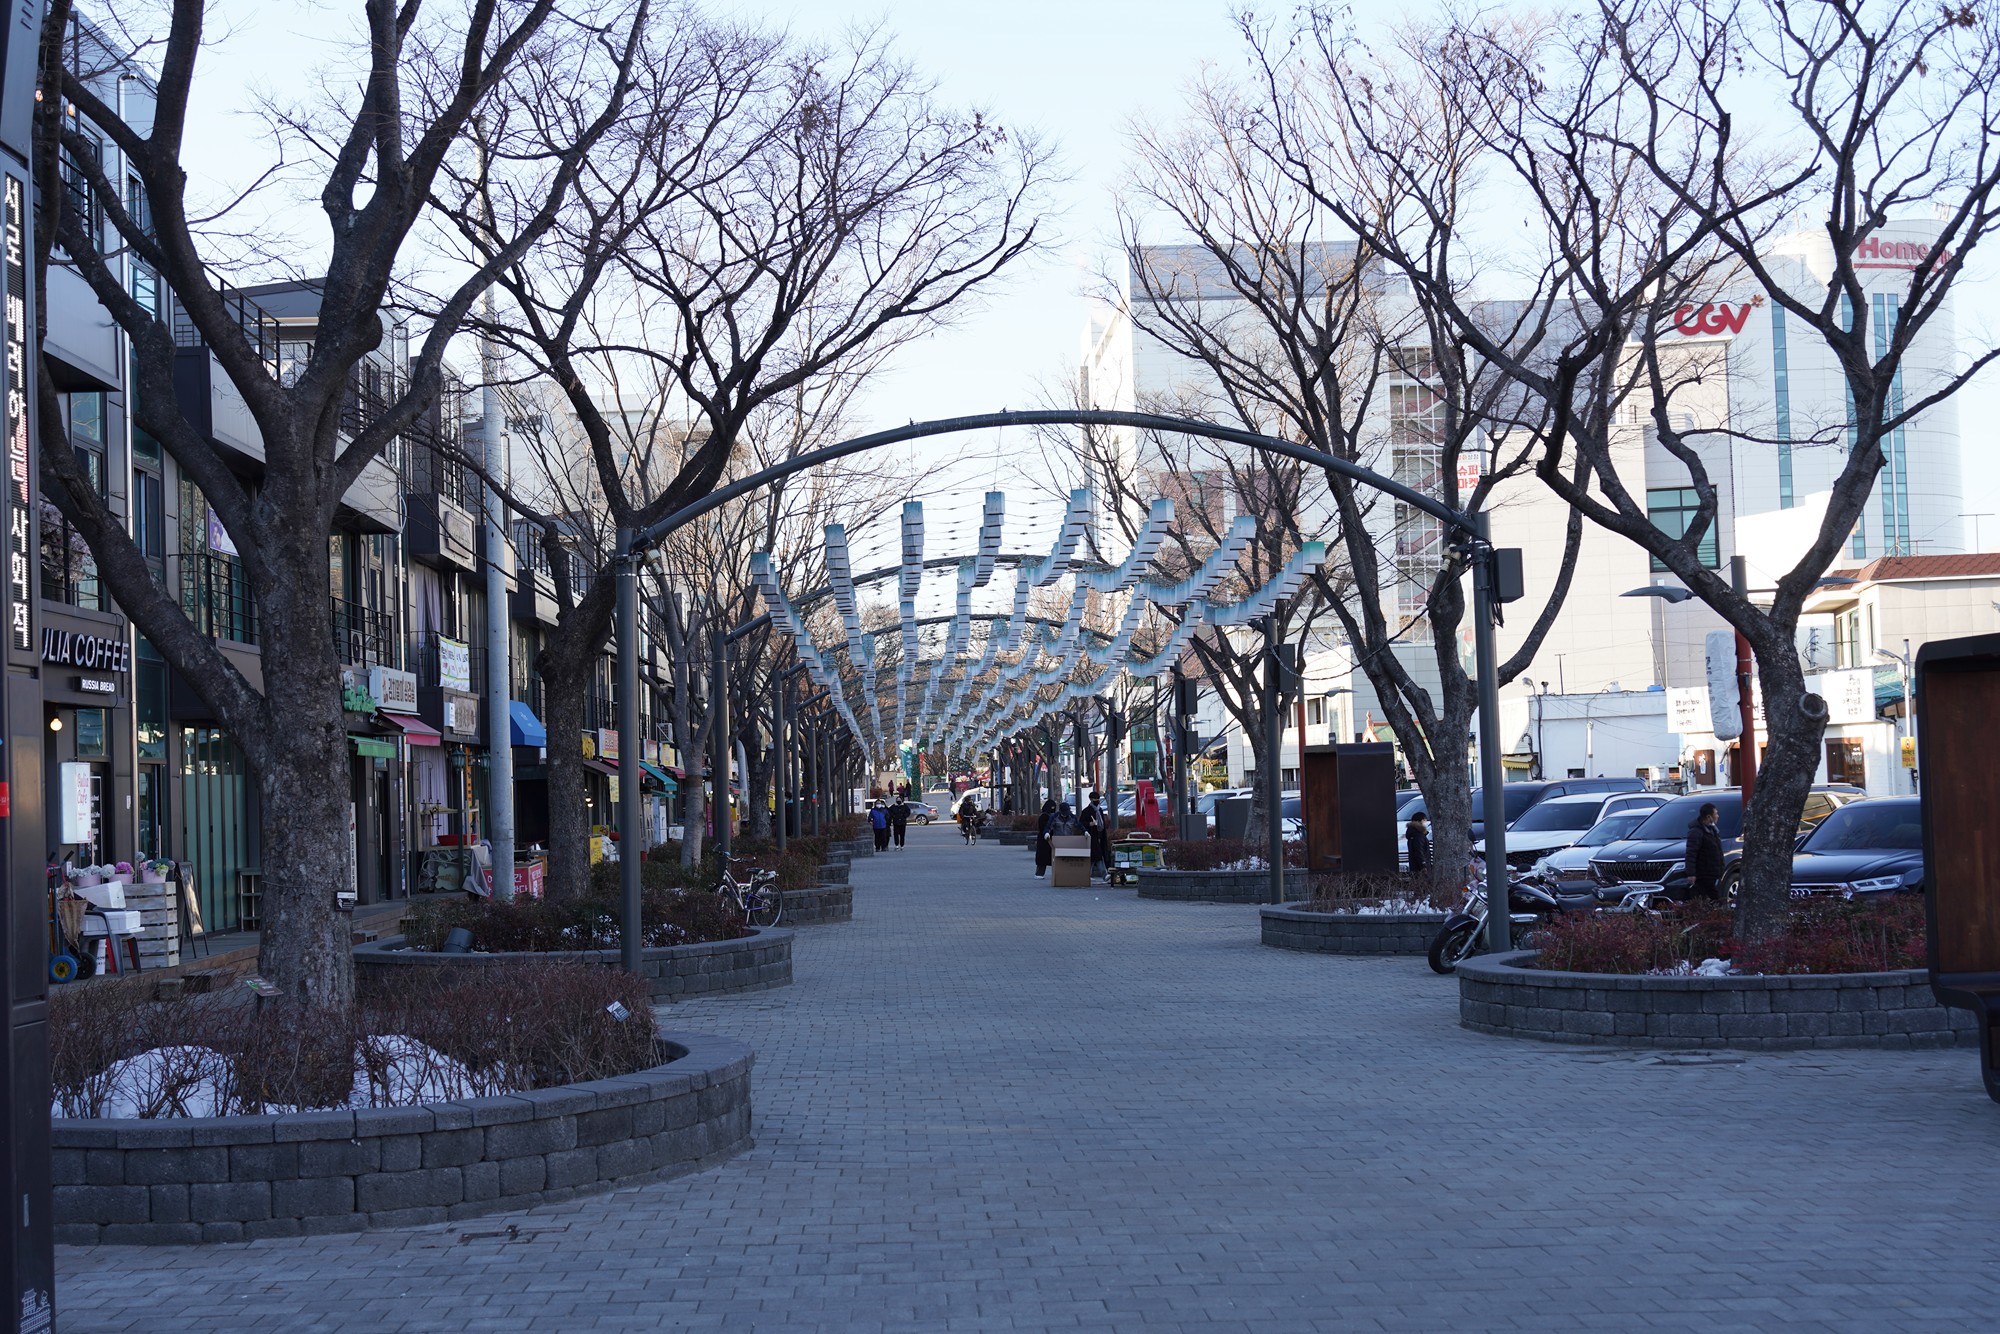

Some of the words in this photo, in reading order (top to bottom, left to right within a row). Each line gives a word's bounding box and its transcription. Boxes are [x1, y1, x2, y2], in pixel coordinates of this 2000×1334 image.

[4, 176, 21, 267] 서로
[1674, 303, 1752, 336] CGV
[1457, 477, 1479, 489] 마켓
[1458, 464, 1479, 476] 슈퍼
[11, 507, 29, 648] 사회적
[75, 633, 129, 672] COFFEE
[82, 678, 99, 690] RUSSIA
[100, 681, 115, 693] BREAD
